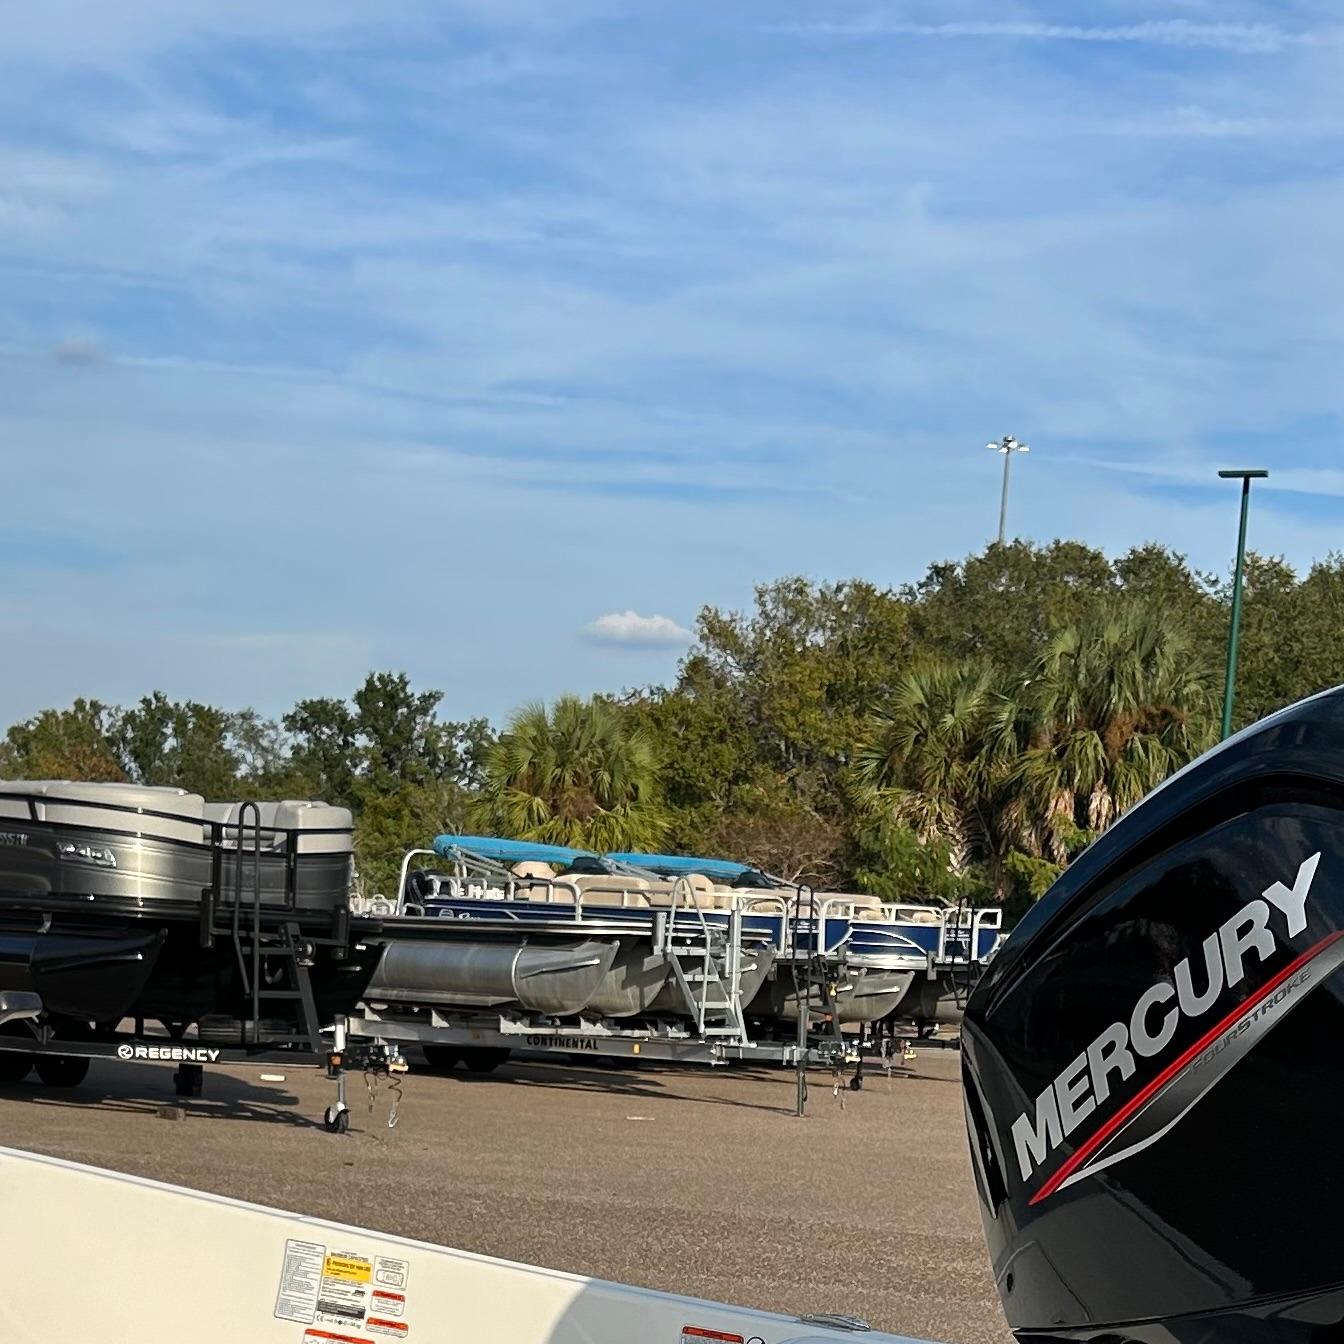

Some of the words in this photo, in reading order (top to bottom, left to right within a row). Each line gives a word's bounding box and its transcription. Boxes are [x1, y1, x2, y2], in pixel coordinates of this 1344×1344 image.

[526, 1035, 599, 1050] CONTINENTAL
[1011, 851, 1322, 1182] MERCURY
[1192, 966, 1312, 1074] FOURSTROKE
[135, 1046, 220, 1062] REGENCY
